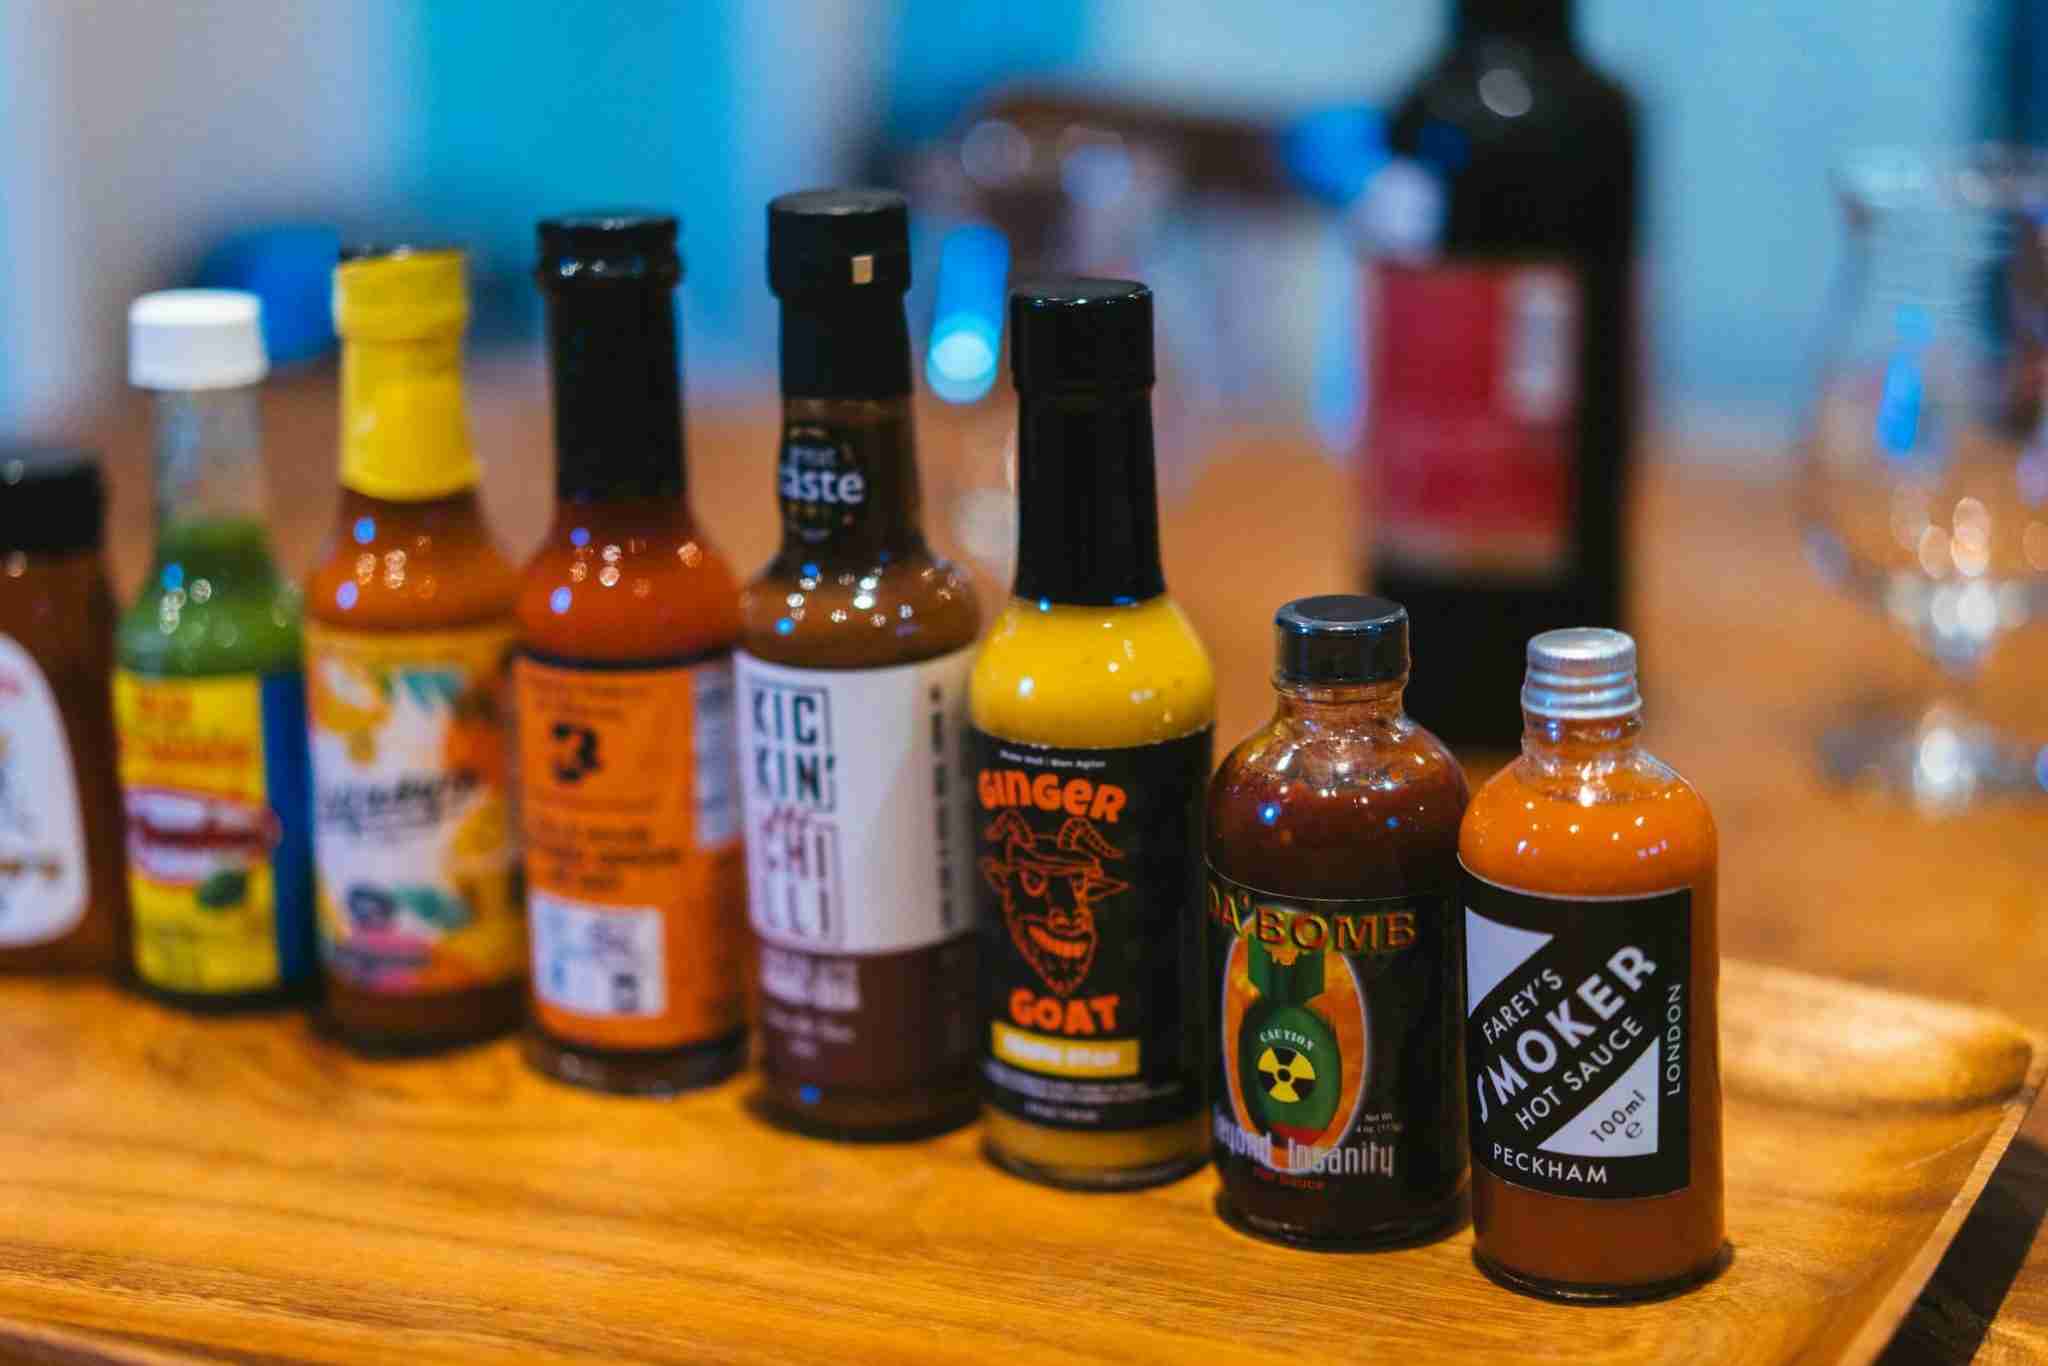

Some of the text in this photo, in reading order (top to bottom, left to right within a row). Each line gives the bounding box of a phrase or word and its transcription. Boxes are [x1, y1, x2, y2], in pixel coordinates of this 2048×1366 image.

[1256, 904, 1416, 951] BOMB
[1009, 987, 1120, 1036] GOAT
[1482, 968, 1563, 1045] FAREY'S
[1667, 983, 1682, 1096] LONDON
[1514, 1017, 1643, 1130] HOT SAUCE
[1590, 1089, 1646, 1142] 100ml
[1288, 1137, 1393, 1177] Insanity
[1493, 1143, 1608, 1184] PECKHAM
